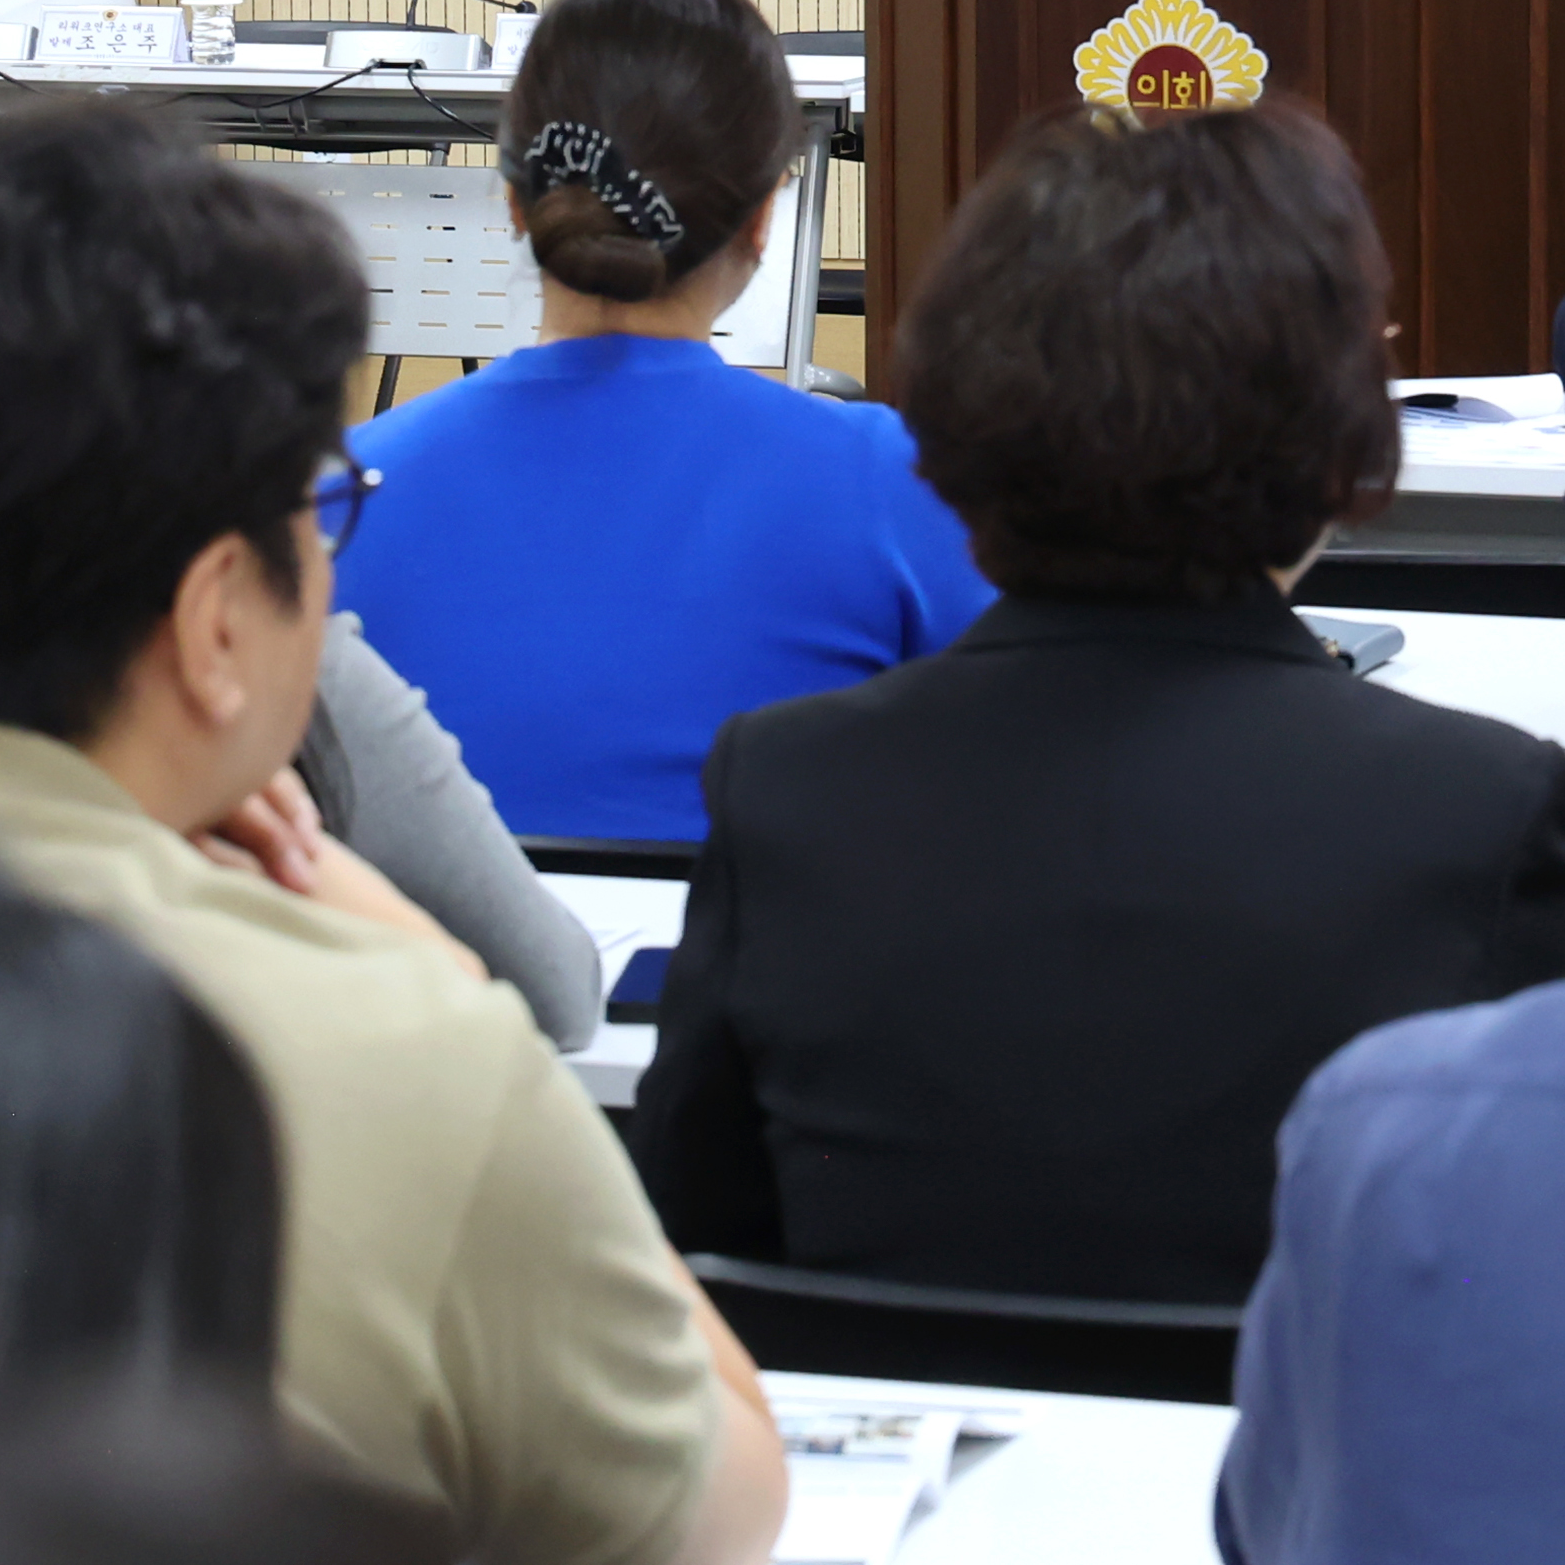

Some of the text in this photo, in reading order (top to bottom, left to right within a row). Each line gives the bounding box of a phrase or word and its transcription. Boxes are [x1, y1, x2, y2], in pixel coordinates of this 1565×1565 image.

[132, 22, 155, 34] 대표
[75, 34, 158, 54] 조은주
[1132, 69, 1208, 110] 의회
